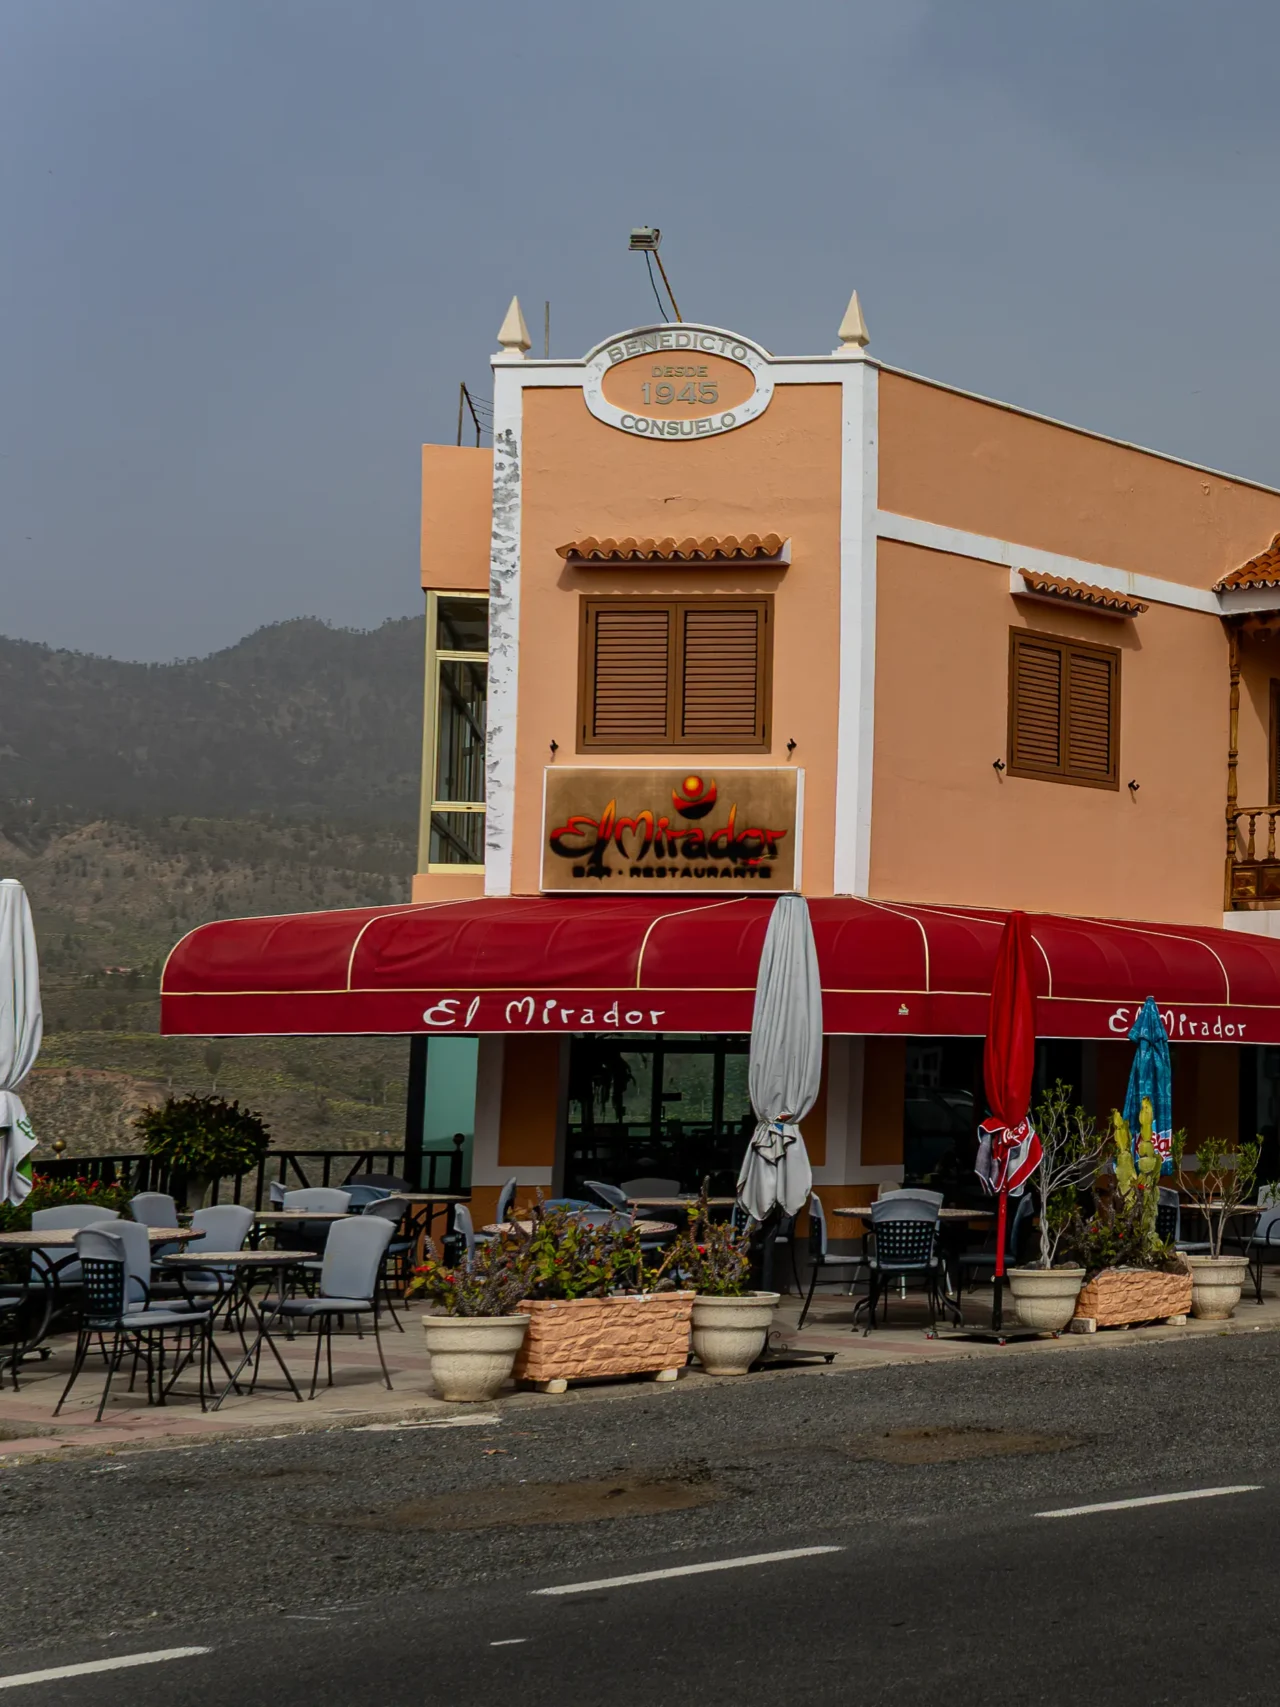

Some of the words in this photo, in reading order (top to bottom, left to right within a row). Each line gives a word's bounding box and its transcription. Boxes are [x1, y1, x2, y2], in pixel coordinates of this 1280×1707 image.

[606, 333, 748, 365] BENEDICTO
[651, 366, 709, 378] DESDE
[641, 380, 720, 405] 1945
[620, 412, 737, 436] CONSUELO
[549, 799, 616, 876] El
[614, 803, 788, 864] Mirador
[572, 866, 612, 879] BAR
[629, 866, 772, 879] RESTAURANTE
[422, 995, 481, 1028] El
[505, 995, 666, 1028] Mirador
[1160, 1009, 1247, 1039] Mirador
